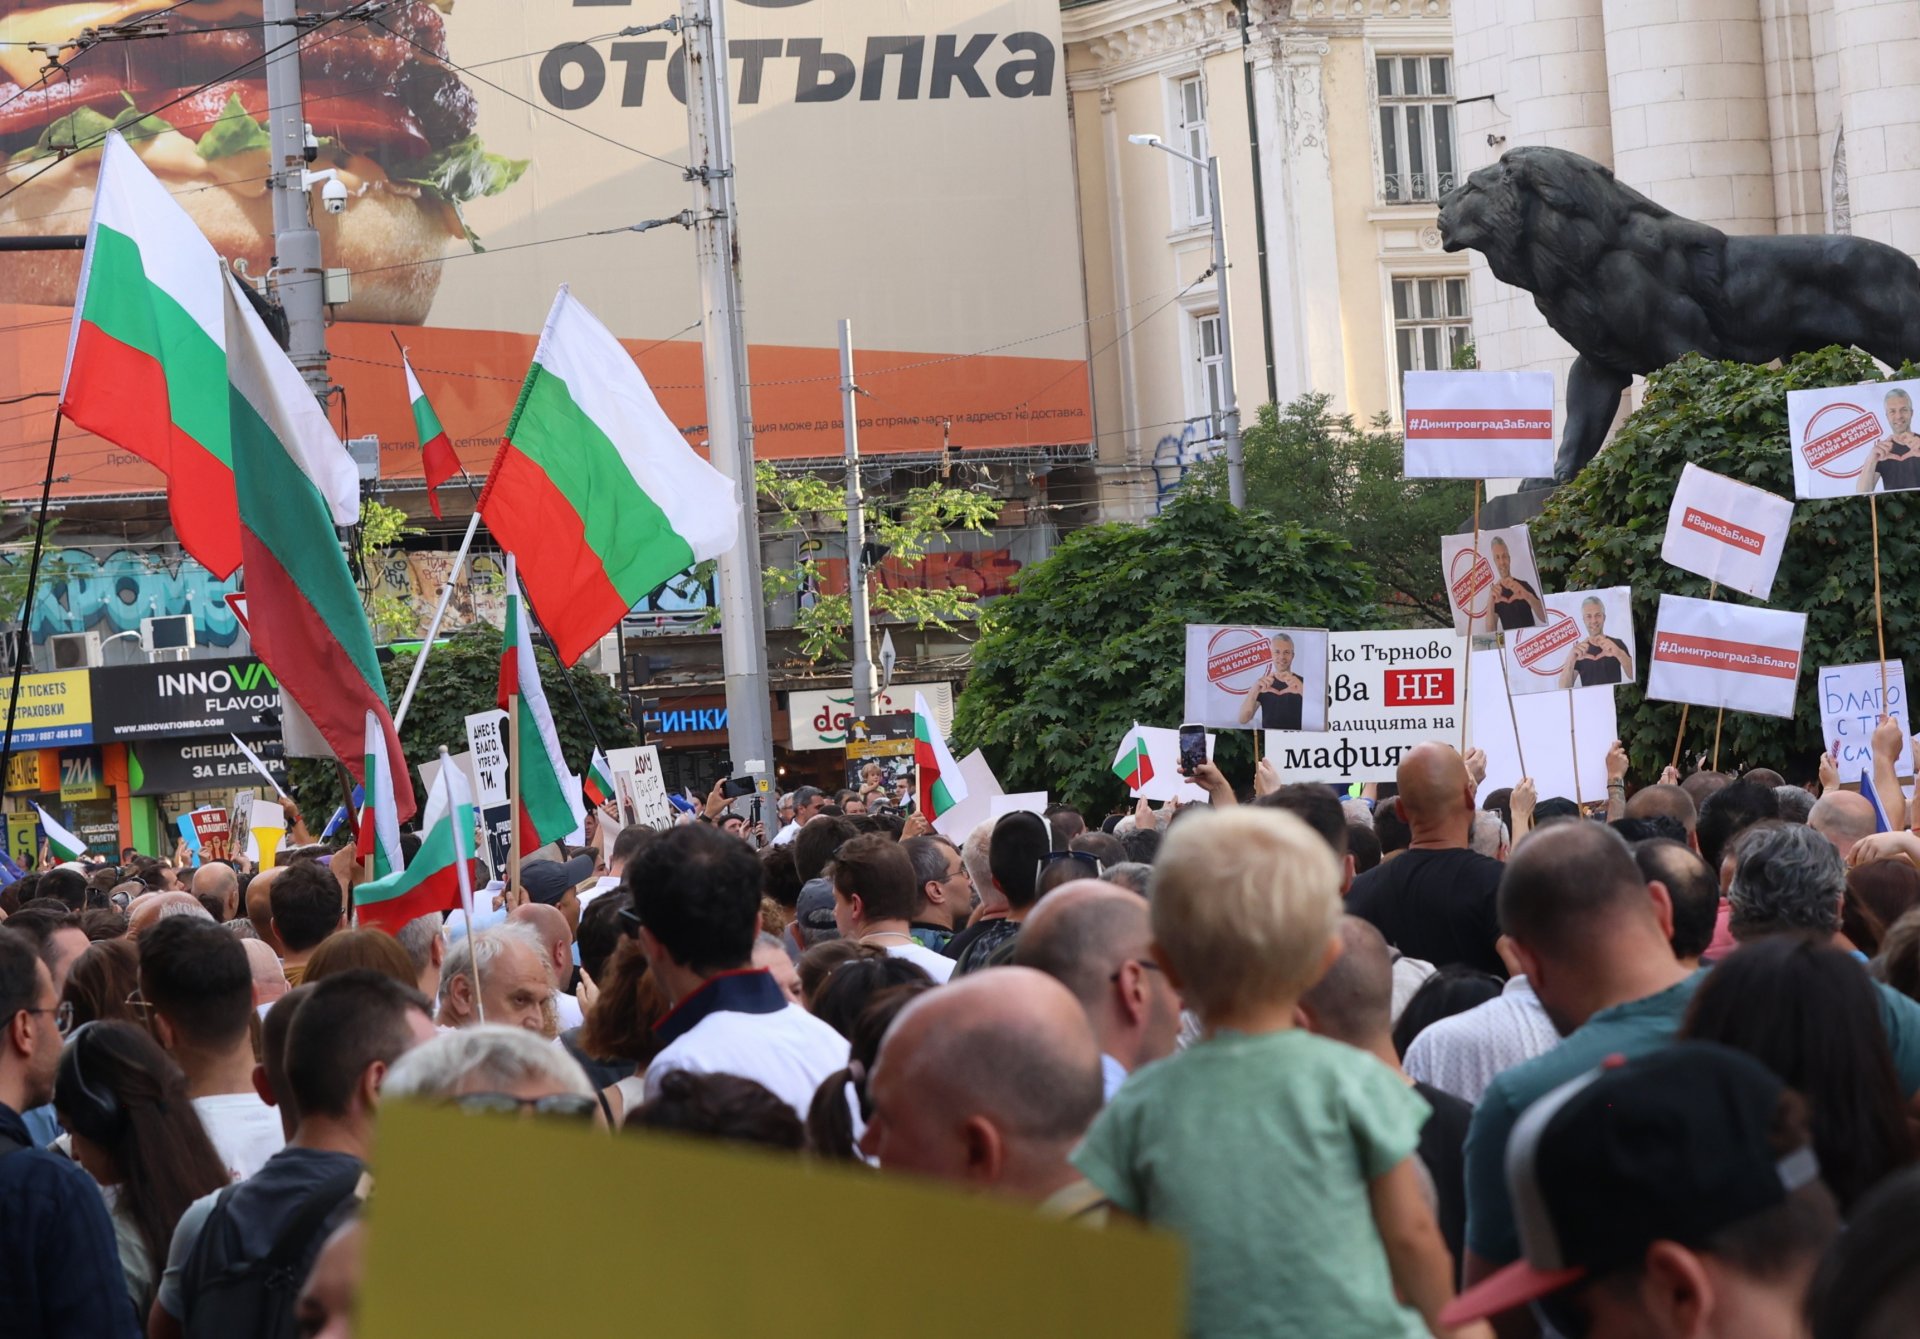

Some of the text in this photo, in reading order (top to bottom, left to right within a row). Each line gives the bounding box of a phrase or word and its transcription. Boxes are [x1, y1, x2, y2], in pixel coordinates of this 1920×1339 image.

[779, 421, 812, 432] може
[814, 421, 829, 431] да
[831, 418, 873, 430] вара
[876, 415, 920, 428] спрямо
[966, 411, 1012, 425] адресът
[1031, 407, 1086, 420] доставка.
[1409, 418, 1551, 431] #ДимитровградЗаБлаго
[1687, 513, 1760, 548] #ВарнаЗаБлаго
[1209, 642, 1268, 669] ДИМИТРОВГРАД
[1233, 654, 1261, 669] БЛАГО!
[1361, 641, 1452, 665] Търново
[1658, 640, 1796, 669] #ДимитровградЗаБлаго
[28, 682, 66, 697] TICKETS
[1396, 673, 1443, 700] НЕ
[473, 723, 490, 739] ДНЕС
[1329, 717, 1455, 734] алицията на
[192, 765, 213, 778] ЗА
